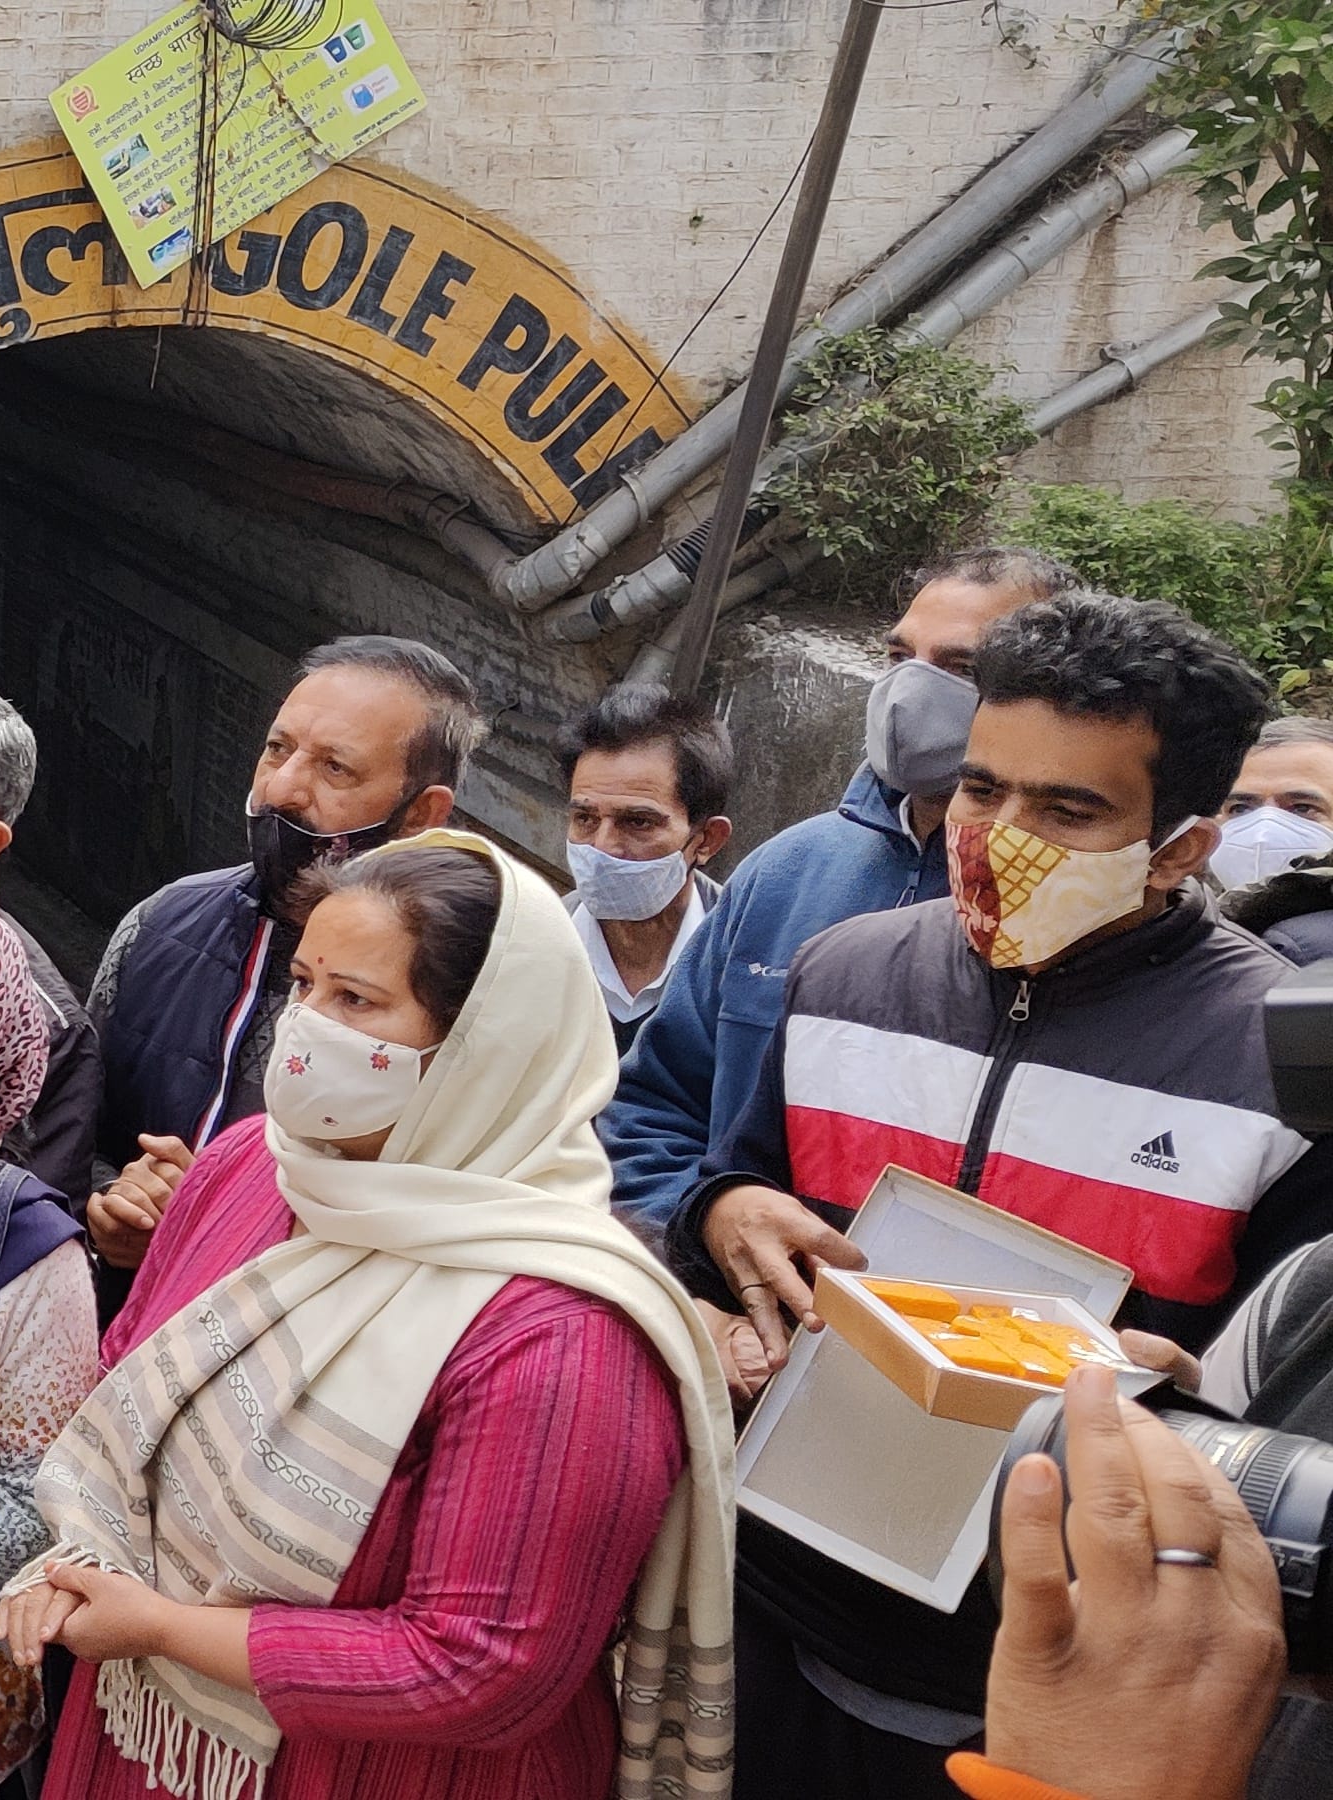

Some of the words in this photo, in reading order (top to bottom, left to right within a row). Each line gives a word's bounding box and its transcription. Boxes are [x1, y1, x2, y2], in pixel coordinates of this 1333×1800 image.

[132, 24, 173, 54] UDHAMPUR
[124, 51, 166, 85] स्वच्छ
[199, 201, 475, 357] GOLE
[1131, 1152, 1180, 1173] adidas
